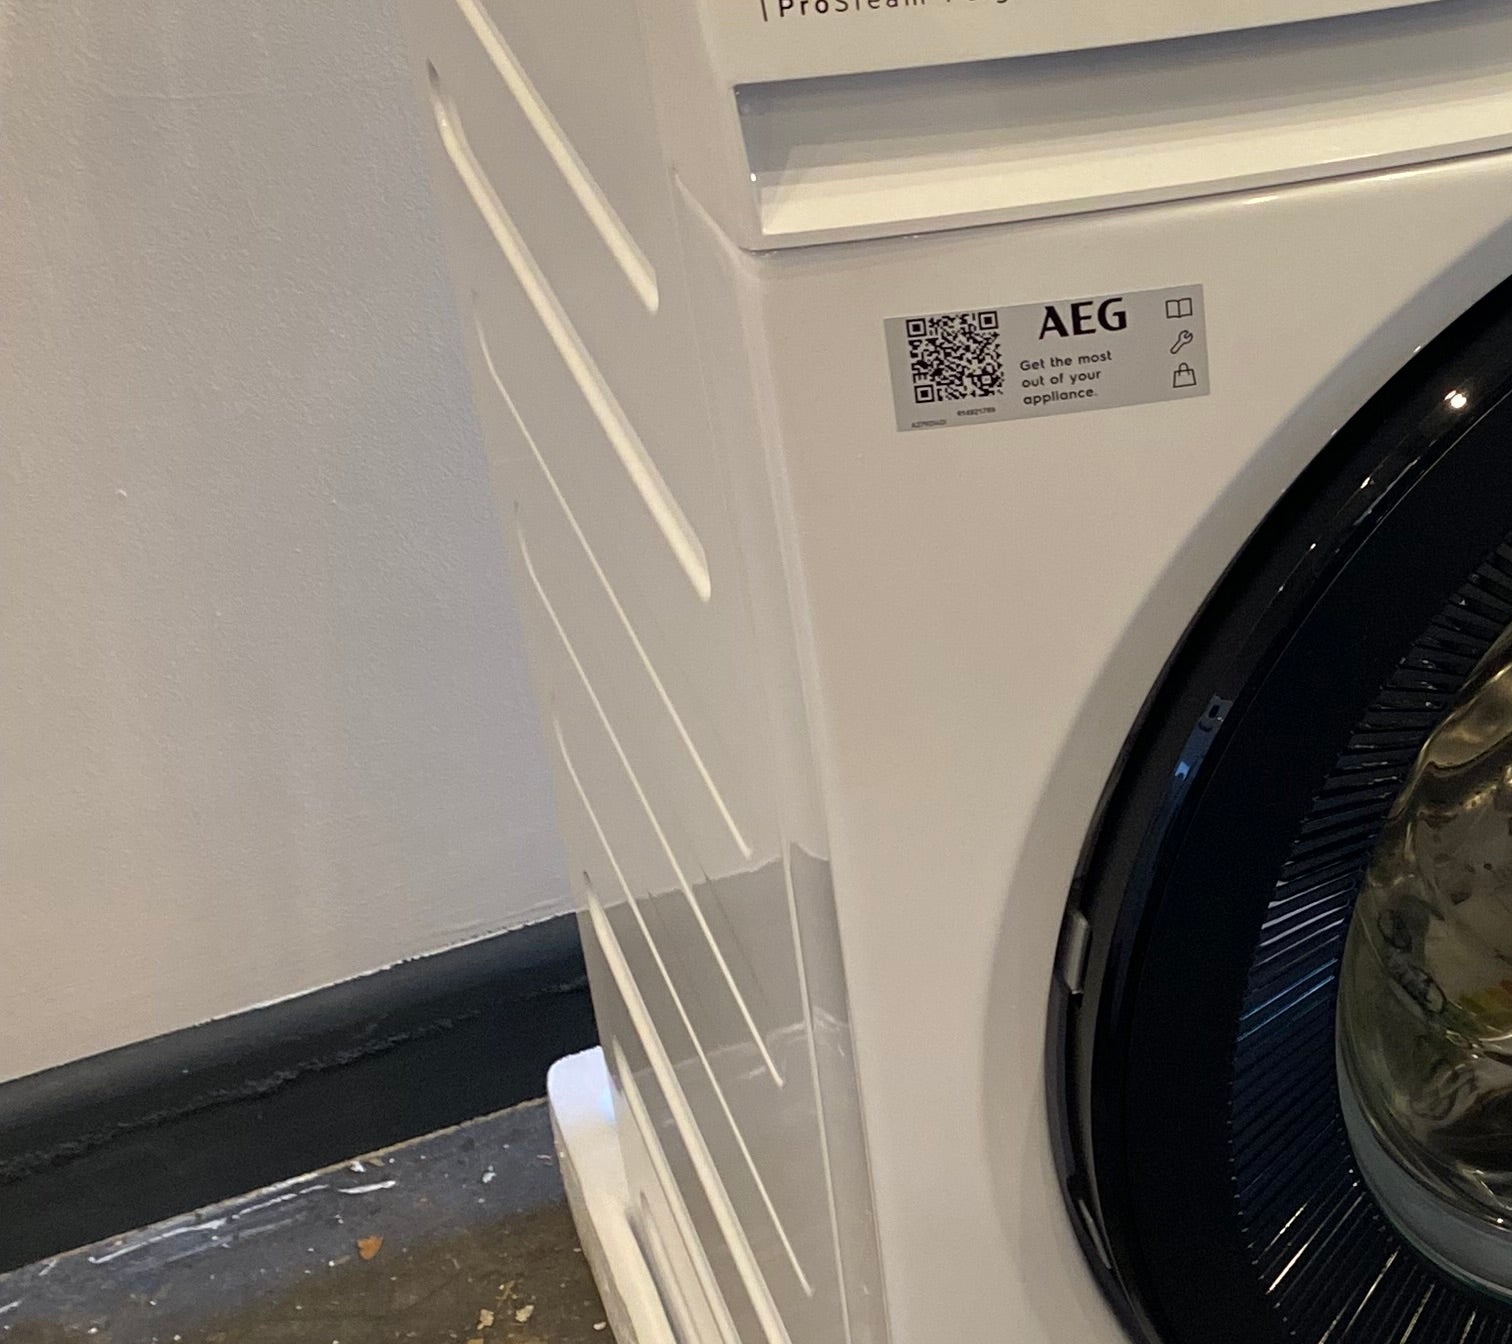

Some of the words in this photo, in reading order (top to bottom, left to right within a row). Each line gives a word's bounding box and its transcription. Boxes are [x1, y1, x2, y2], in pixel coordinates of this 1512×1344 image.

[1038, 298, 1127, 340] AEG
[1020, 358, 1045, 371] Get
[1050, 357, 1072, 367] the
[1078, 350, 1112, 364] most
[1022, 376, 1045, 388] out
[1050, 373, 1064, 384] of
[1069, 370, 1101, 385] your
[1023, 388, 1098, 406] appliance.
